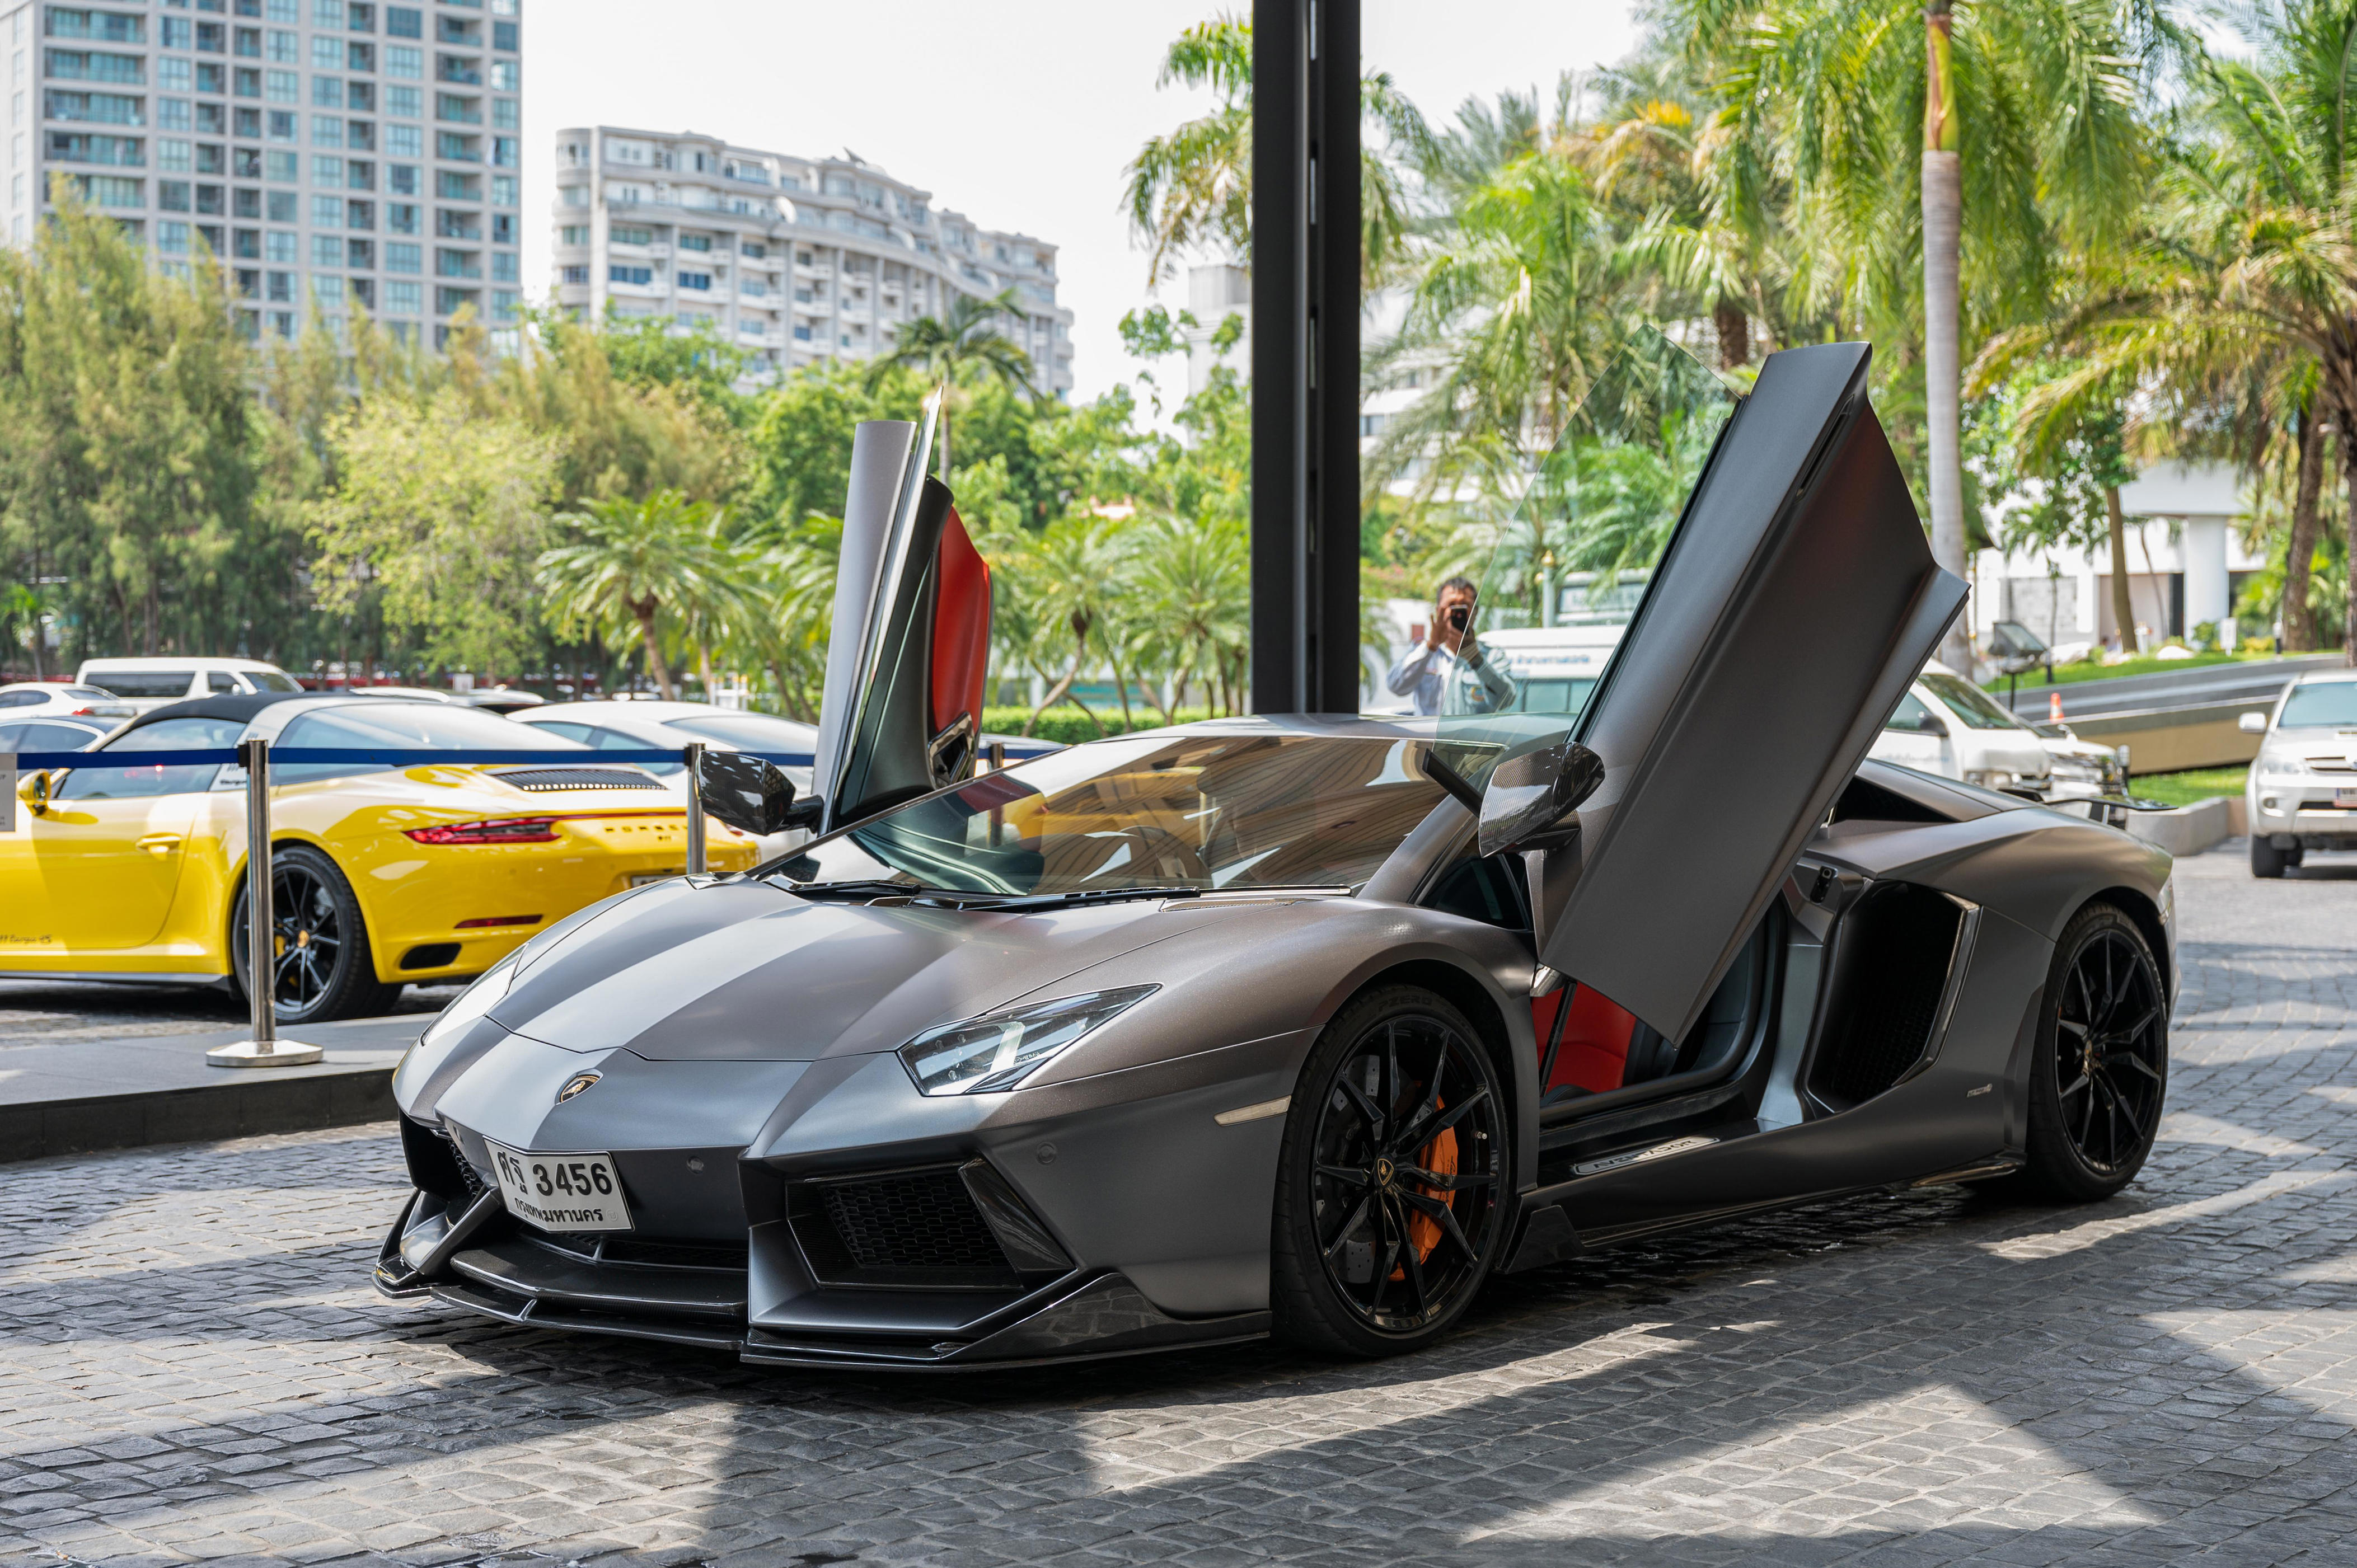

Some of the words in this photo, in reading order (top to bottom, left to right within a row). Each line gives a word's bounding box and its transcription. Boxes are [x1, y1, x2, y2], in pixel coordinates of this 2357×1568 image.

[532, 1163, 612, 1196] 3456
[514, 1197, 603, 1223] กรุงเทพมหานคร
